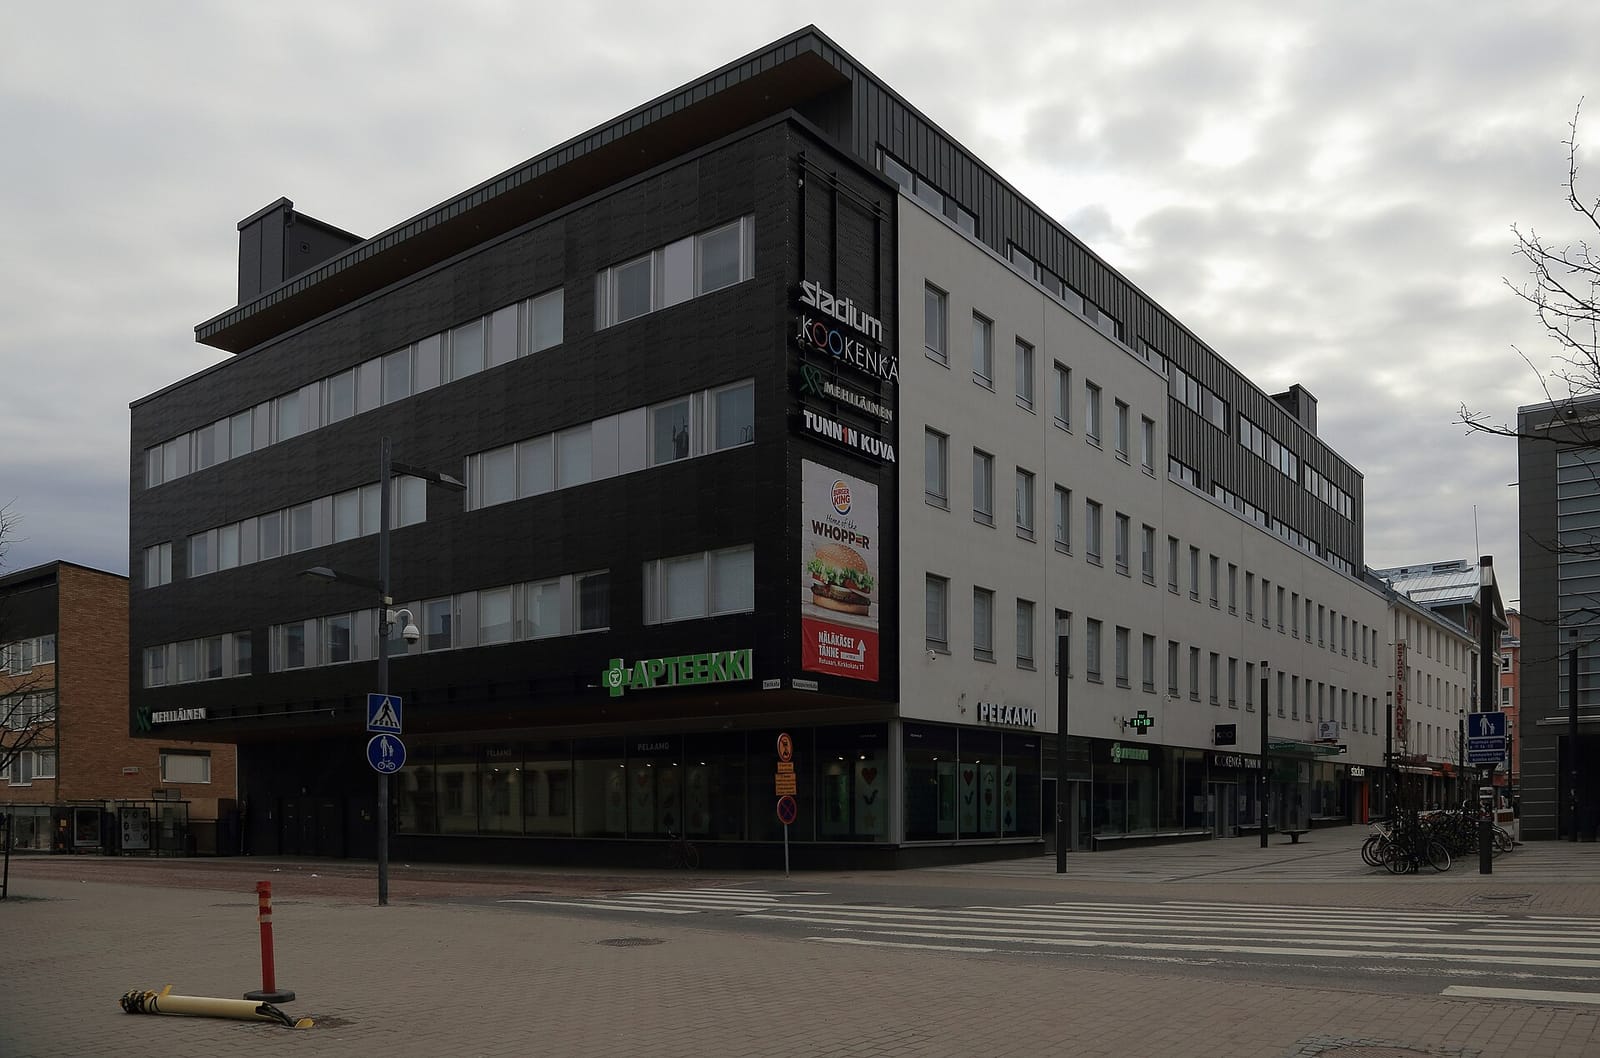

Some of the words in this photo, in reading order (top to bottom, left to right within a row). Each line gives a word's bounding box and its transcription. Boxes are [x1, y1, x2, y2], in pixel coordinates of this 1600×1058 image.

[800, 280, 882, 342] stadium
[802, 314, 900, 384] KOOKENKÄ
[823, 381, 893, 422] MEHILÄINEN
[860, 433, 896, 463] KUVA
[833, 488, 850, 496] BURGER
[833, 495, 851, 506] KING
[825, 513, 841, 526] Home
[848, 519, 858, 530] the
[811, 519, 870, 550] WHOPPER
[818, 630, 854, 648] NÄLÄKÄSET
[818, 643, 839, 659] TÄNNE
[630, 648, 753, 690] APTEEKKI
[152, 707, 207, 724] MEHILÄINEN
[977, 702, 1038, 727] PELAAMO
[637, 742, 670, 751] PELAAMO
